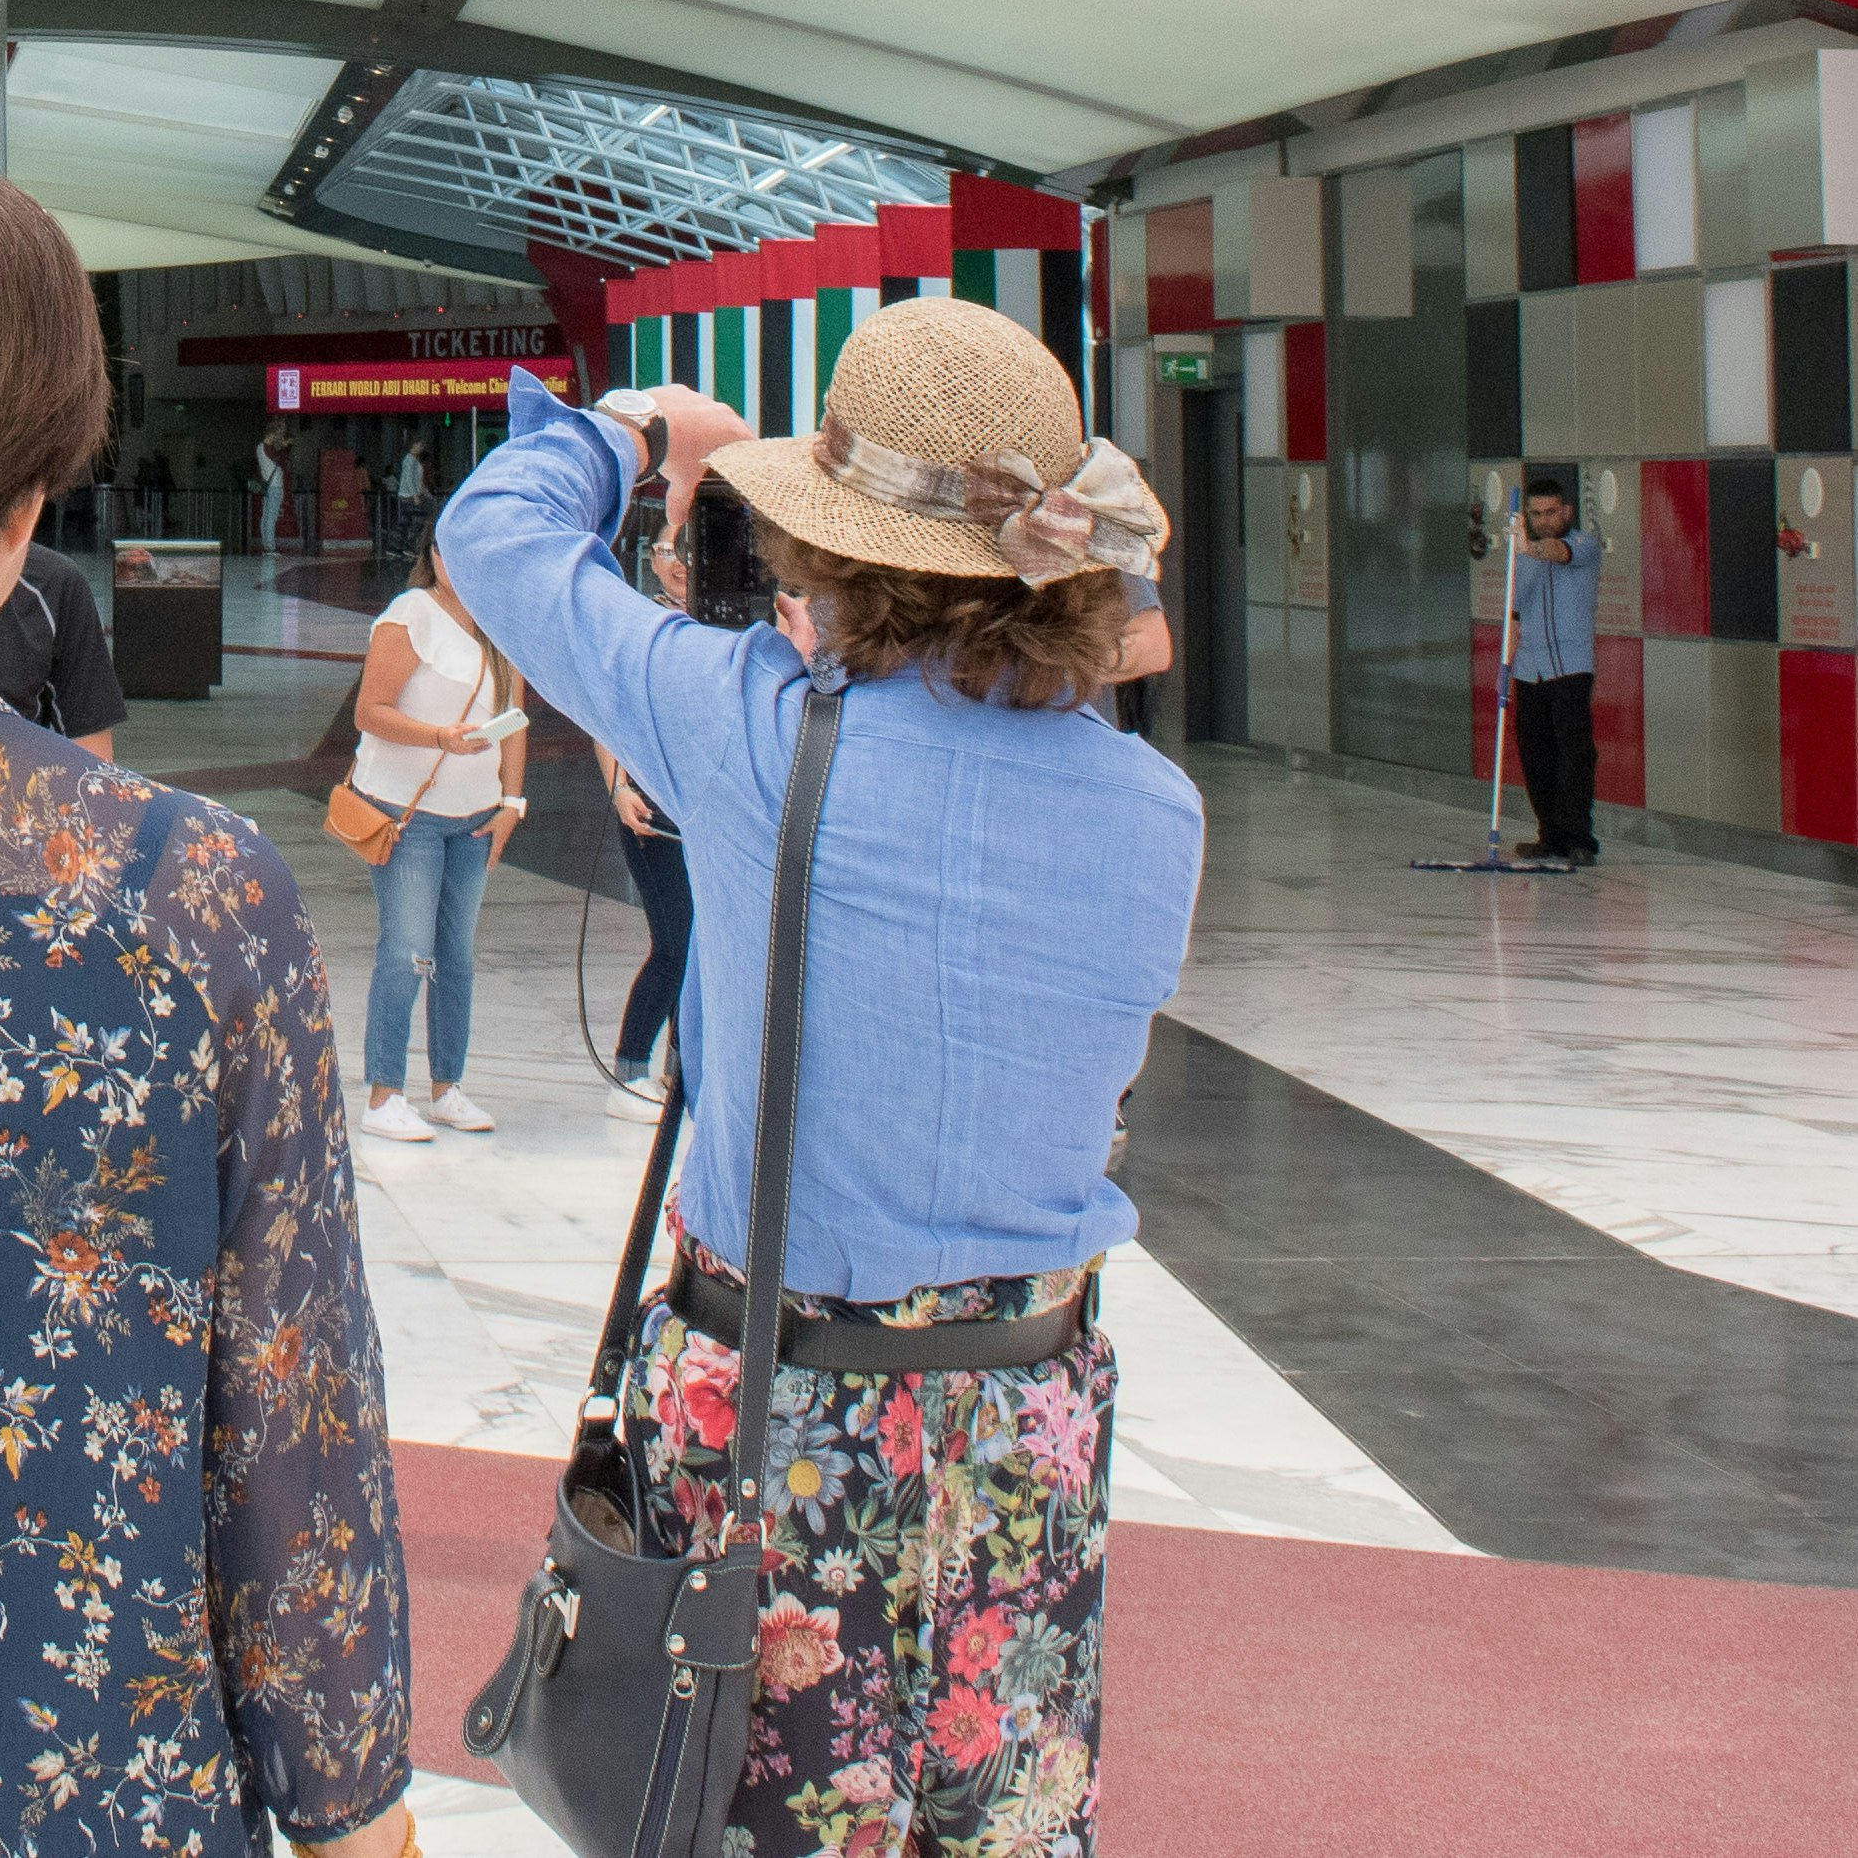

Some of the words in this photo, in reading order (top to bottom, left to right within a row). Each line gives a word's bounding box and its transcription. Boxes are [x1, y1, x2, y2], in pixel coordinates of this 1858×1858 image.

[408, 328, 546, 358] TICKETING
[310, 380, 347, 397] FERRARI
[348, 379, 381, 396] WORLD
[381, 379, 400, 395] ABU
[402, 378, 430, 395] DHABI
[431, 378, 441, 394] is
